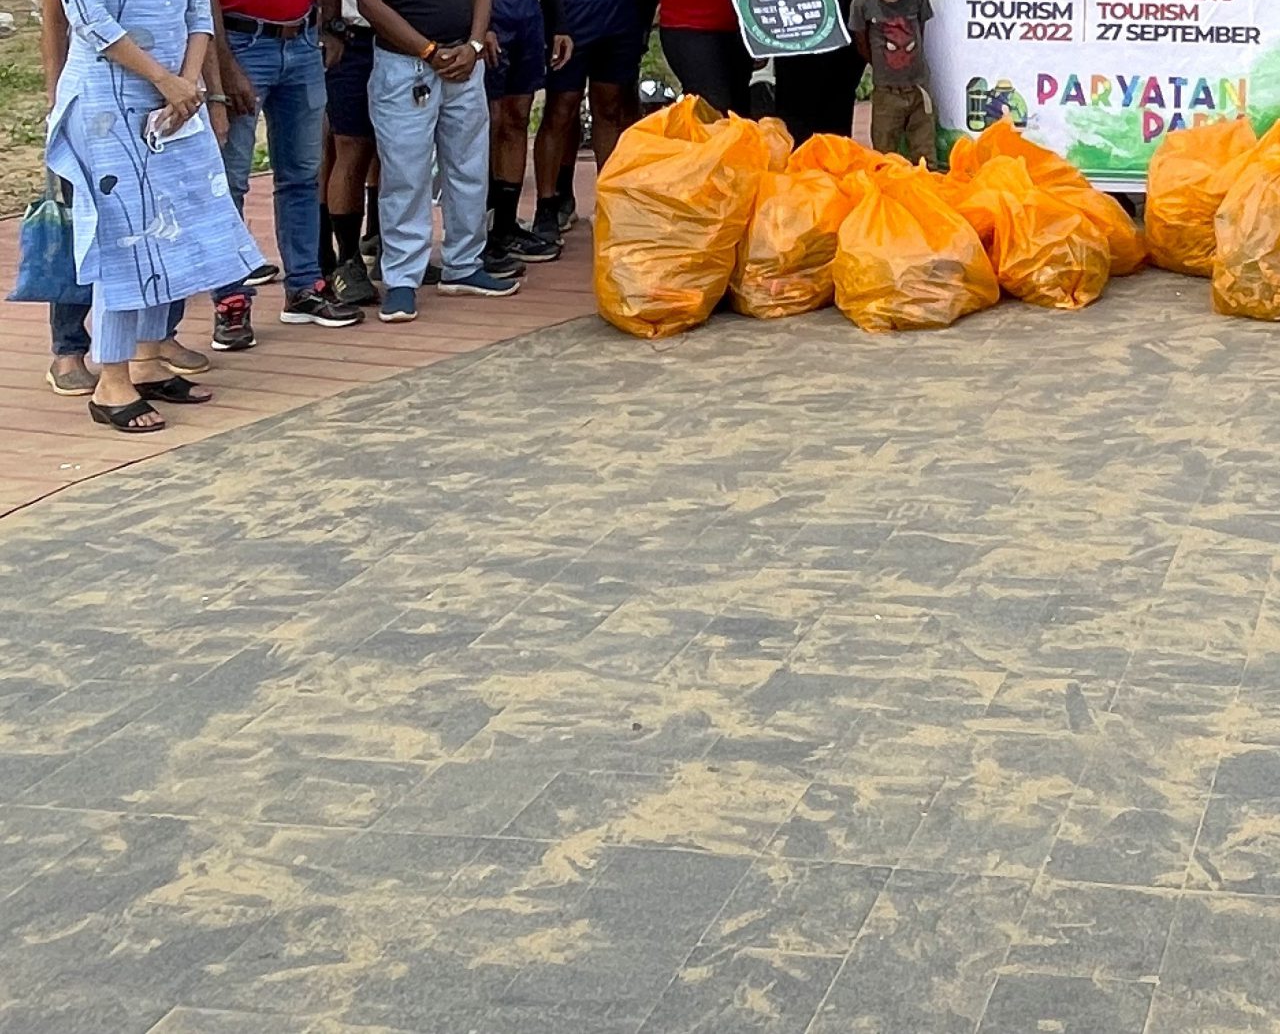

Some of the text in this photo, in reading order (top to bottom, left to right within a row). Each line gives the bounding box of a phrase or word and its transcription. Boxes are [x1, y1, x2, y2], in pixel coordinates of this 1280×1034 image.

[966, 0, 1073, 20] TOURISM
[1096, 1, 1200, 22] TOURISM
[966, 21, 1073, 42] DAY 2022
[1096, 23, 1261, 45] 27 SEPTEMBER
[1036, 73, 1247, 113] PARYATAN
